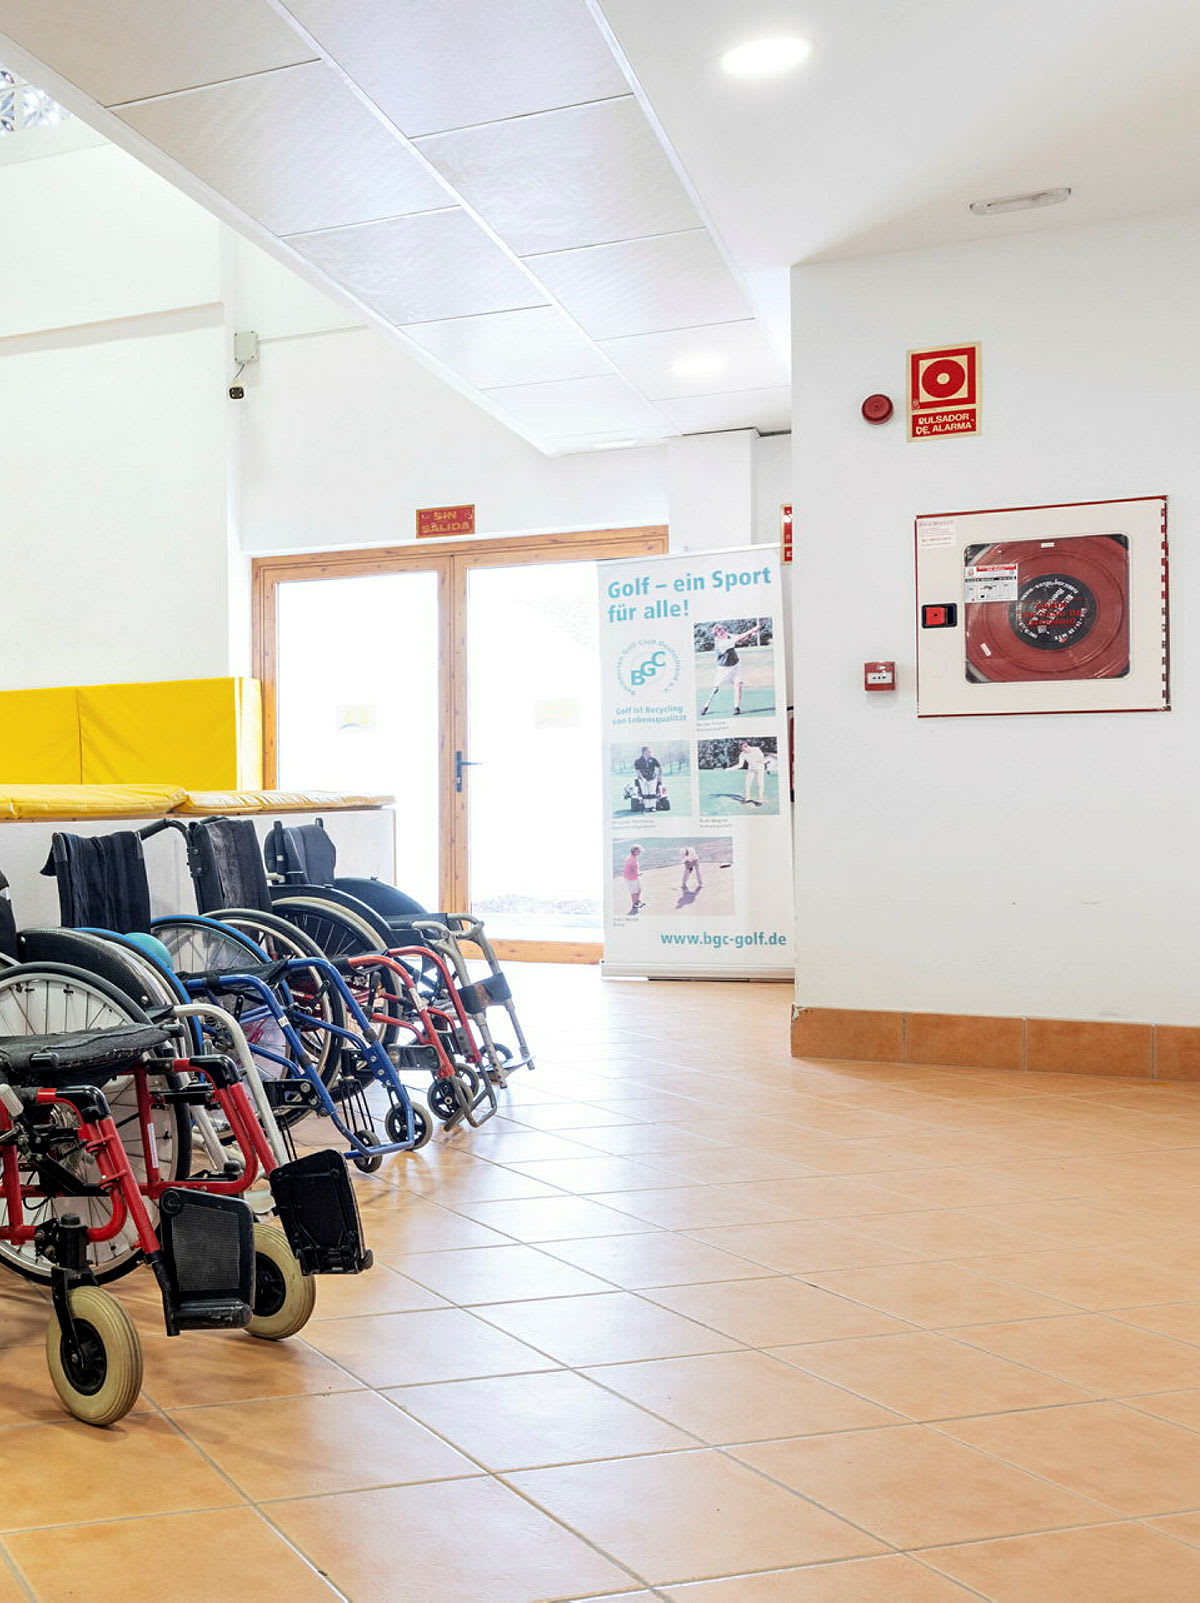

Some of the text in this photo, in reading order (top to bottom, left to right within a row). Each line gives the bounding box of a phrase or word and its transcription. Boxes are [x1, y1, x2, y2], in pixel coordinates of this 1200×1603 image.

[918, 413, 970, 425] PULSADOR
[915, 421, 972, 435] DE ALARMA
[422, 521, 470, 533] SALIDA
[607, 577, 650, 599] Golf
[673, 573, 705, 592] ein
[712, 567, 772, 592] Sport
[607, 599, 689, 623] für alle!
[630, 650, 666, 687] BGC
[645, 704, 683, 715] Recycling
[660, 931, 787, 949] www.bgc-golf.de
